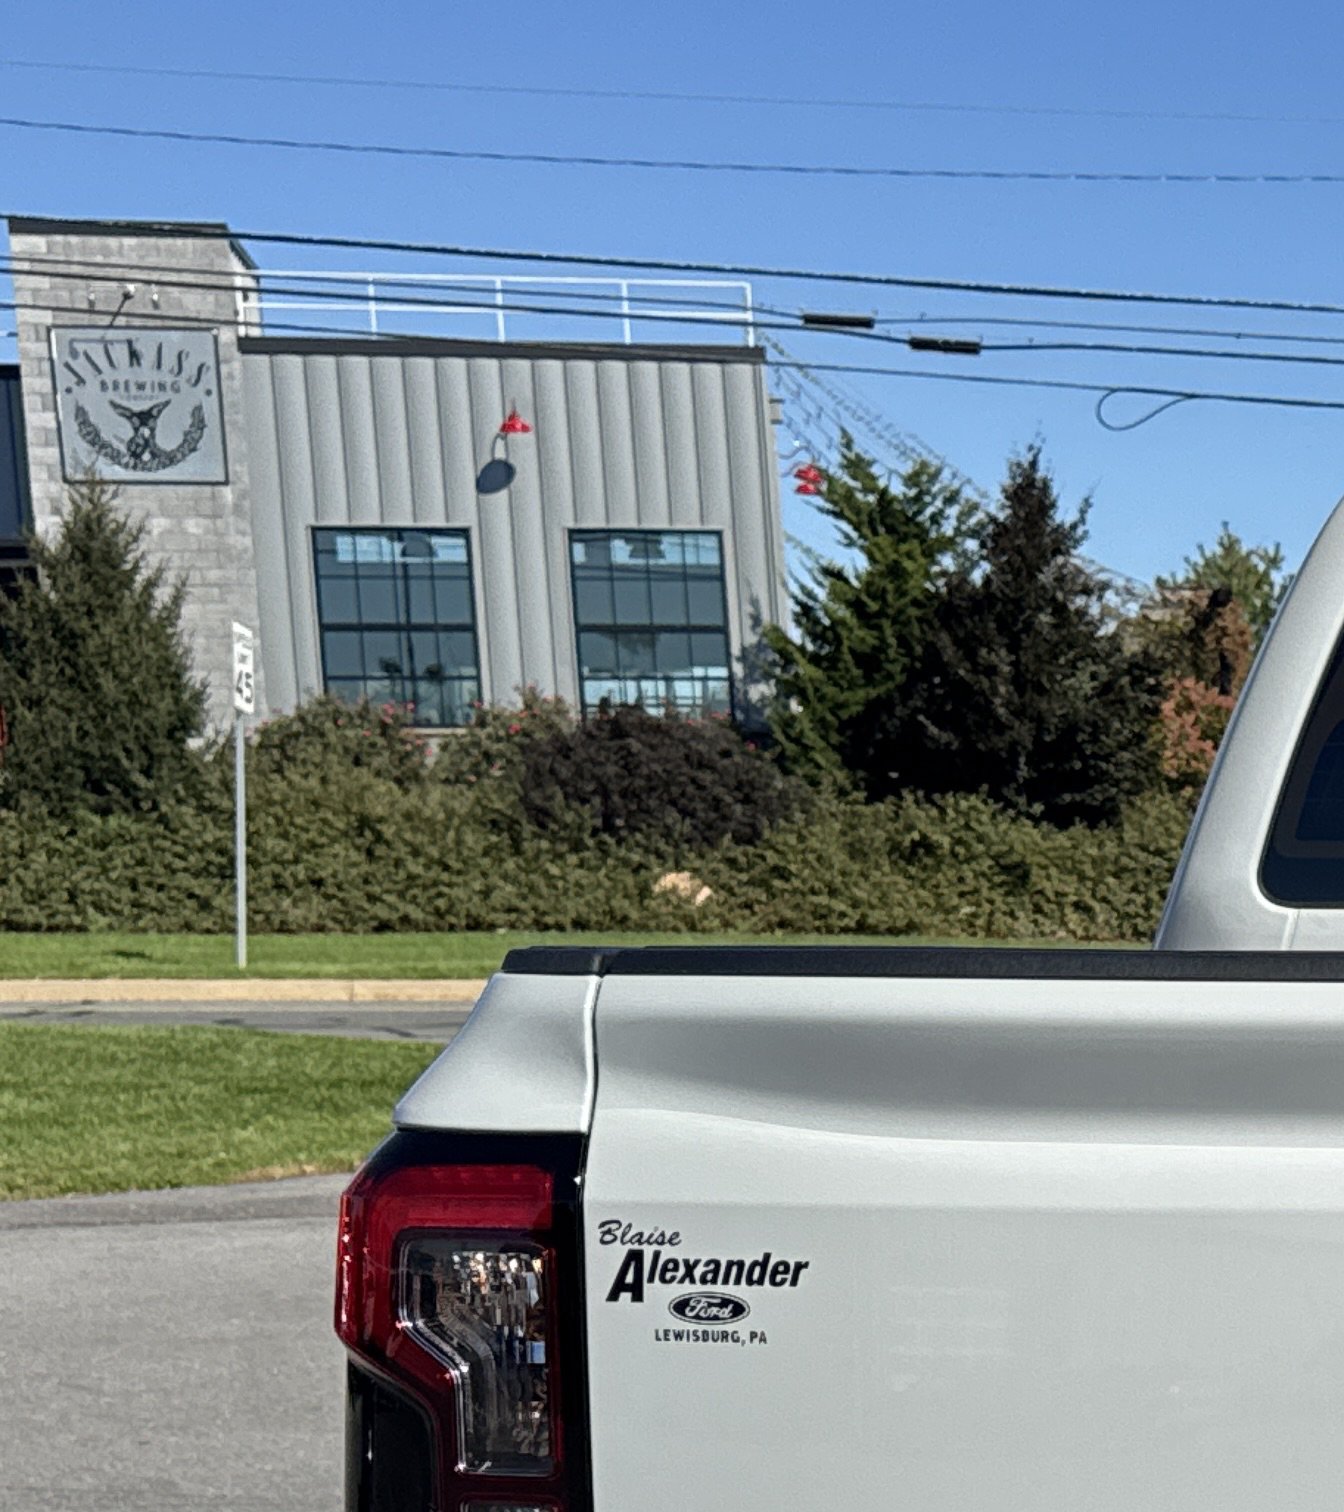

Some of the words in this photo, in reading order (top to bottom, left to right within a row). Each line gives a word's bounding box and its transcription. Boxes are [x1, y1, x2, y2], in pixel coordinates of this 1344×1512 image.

[100, 379, 181, 394] BREWING
[235, 669, 254, 704] 45
[597, 1219, 682, 1247] Blaise
[605, 1248, 810, 1303] Alexander
[684, 1296, 734, 1319] Ford
[654, 1328, 747, 1347] LEWISBURG,
[749, 1330, 768, 1345] PA
